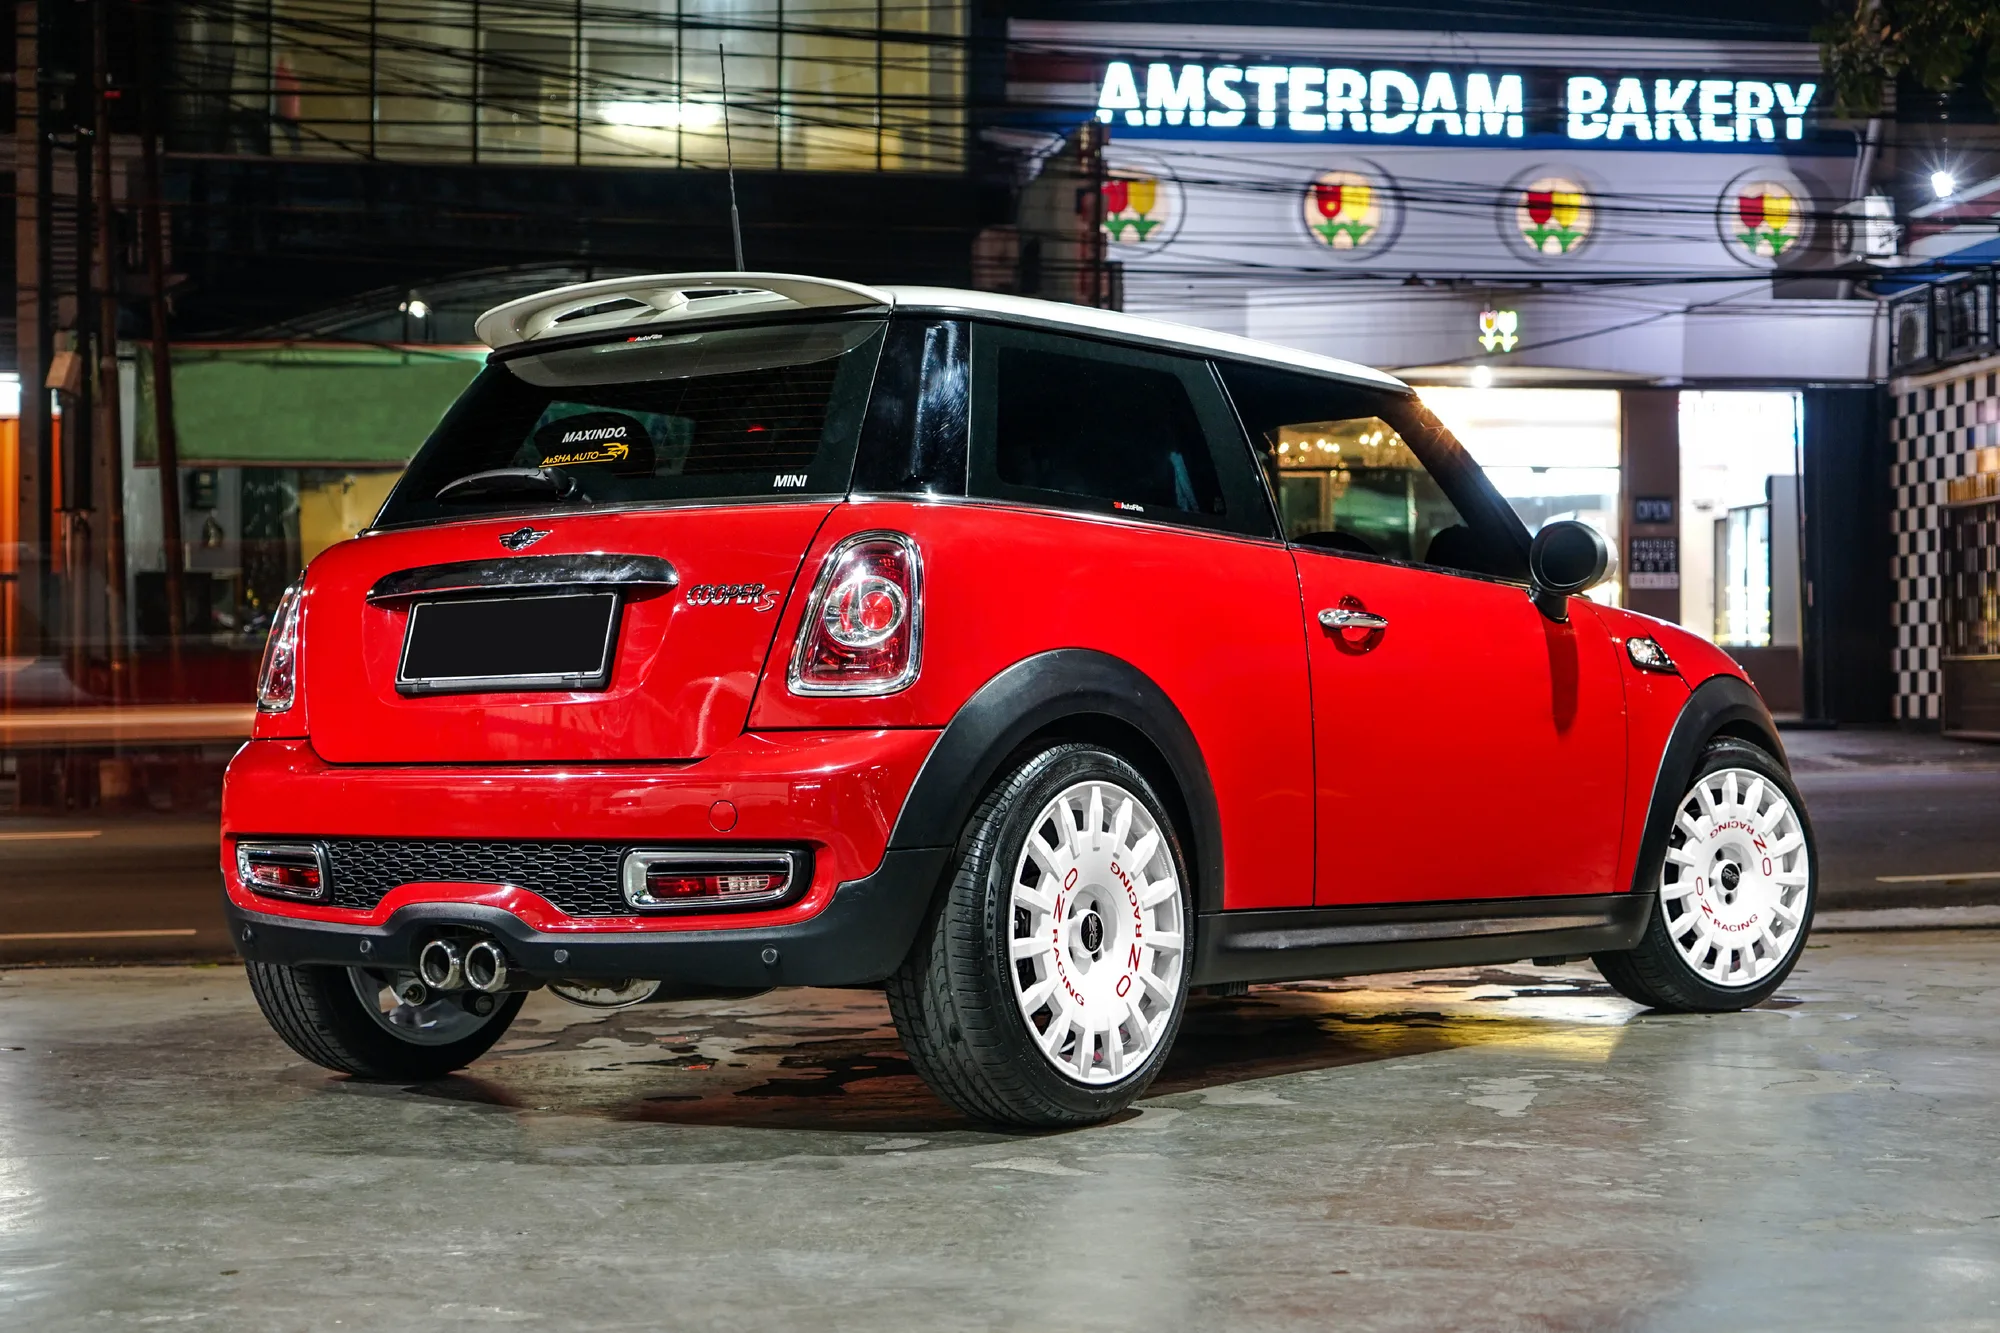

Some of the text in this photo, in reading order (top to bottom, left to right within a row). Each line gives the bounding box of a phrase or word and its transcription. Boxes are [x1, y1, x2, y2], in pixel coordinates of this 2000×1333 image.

[1096, 61, 1817, 142] AMSTERDAM BAKERY
[562, 426, 627, 444] MAXINDO.
[572, 450, 600, 462] AUTO
[773, 474, 808, 488] MINI
[686, 583, 780, 612] COOPER S
[1709, 820, 1755, 839] RACING
[1110, 861, 1142, 938] RACING
[1713, 913, 1758, 932] RACING
[1052, 929, 1085, 1006] RACING
